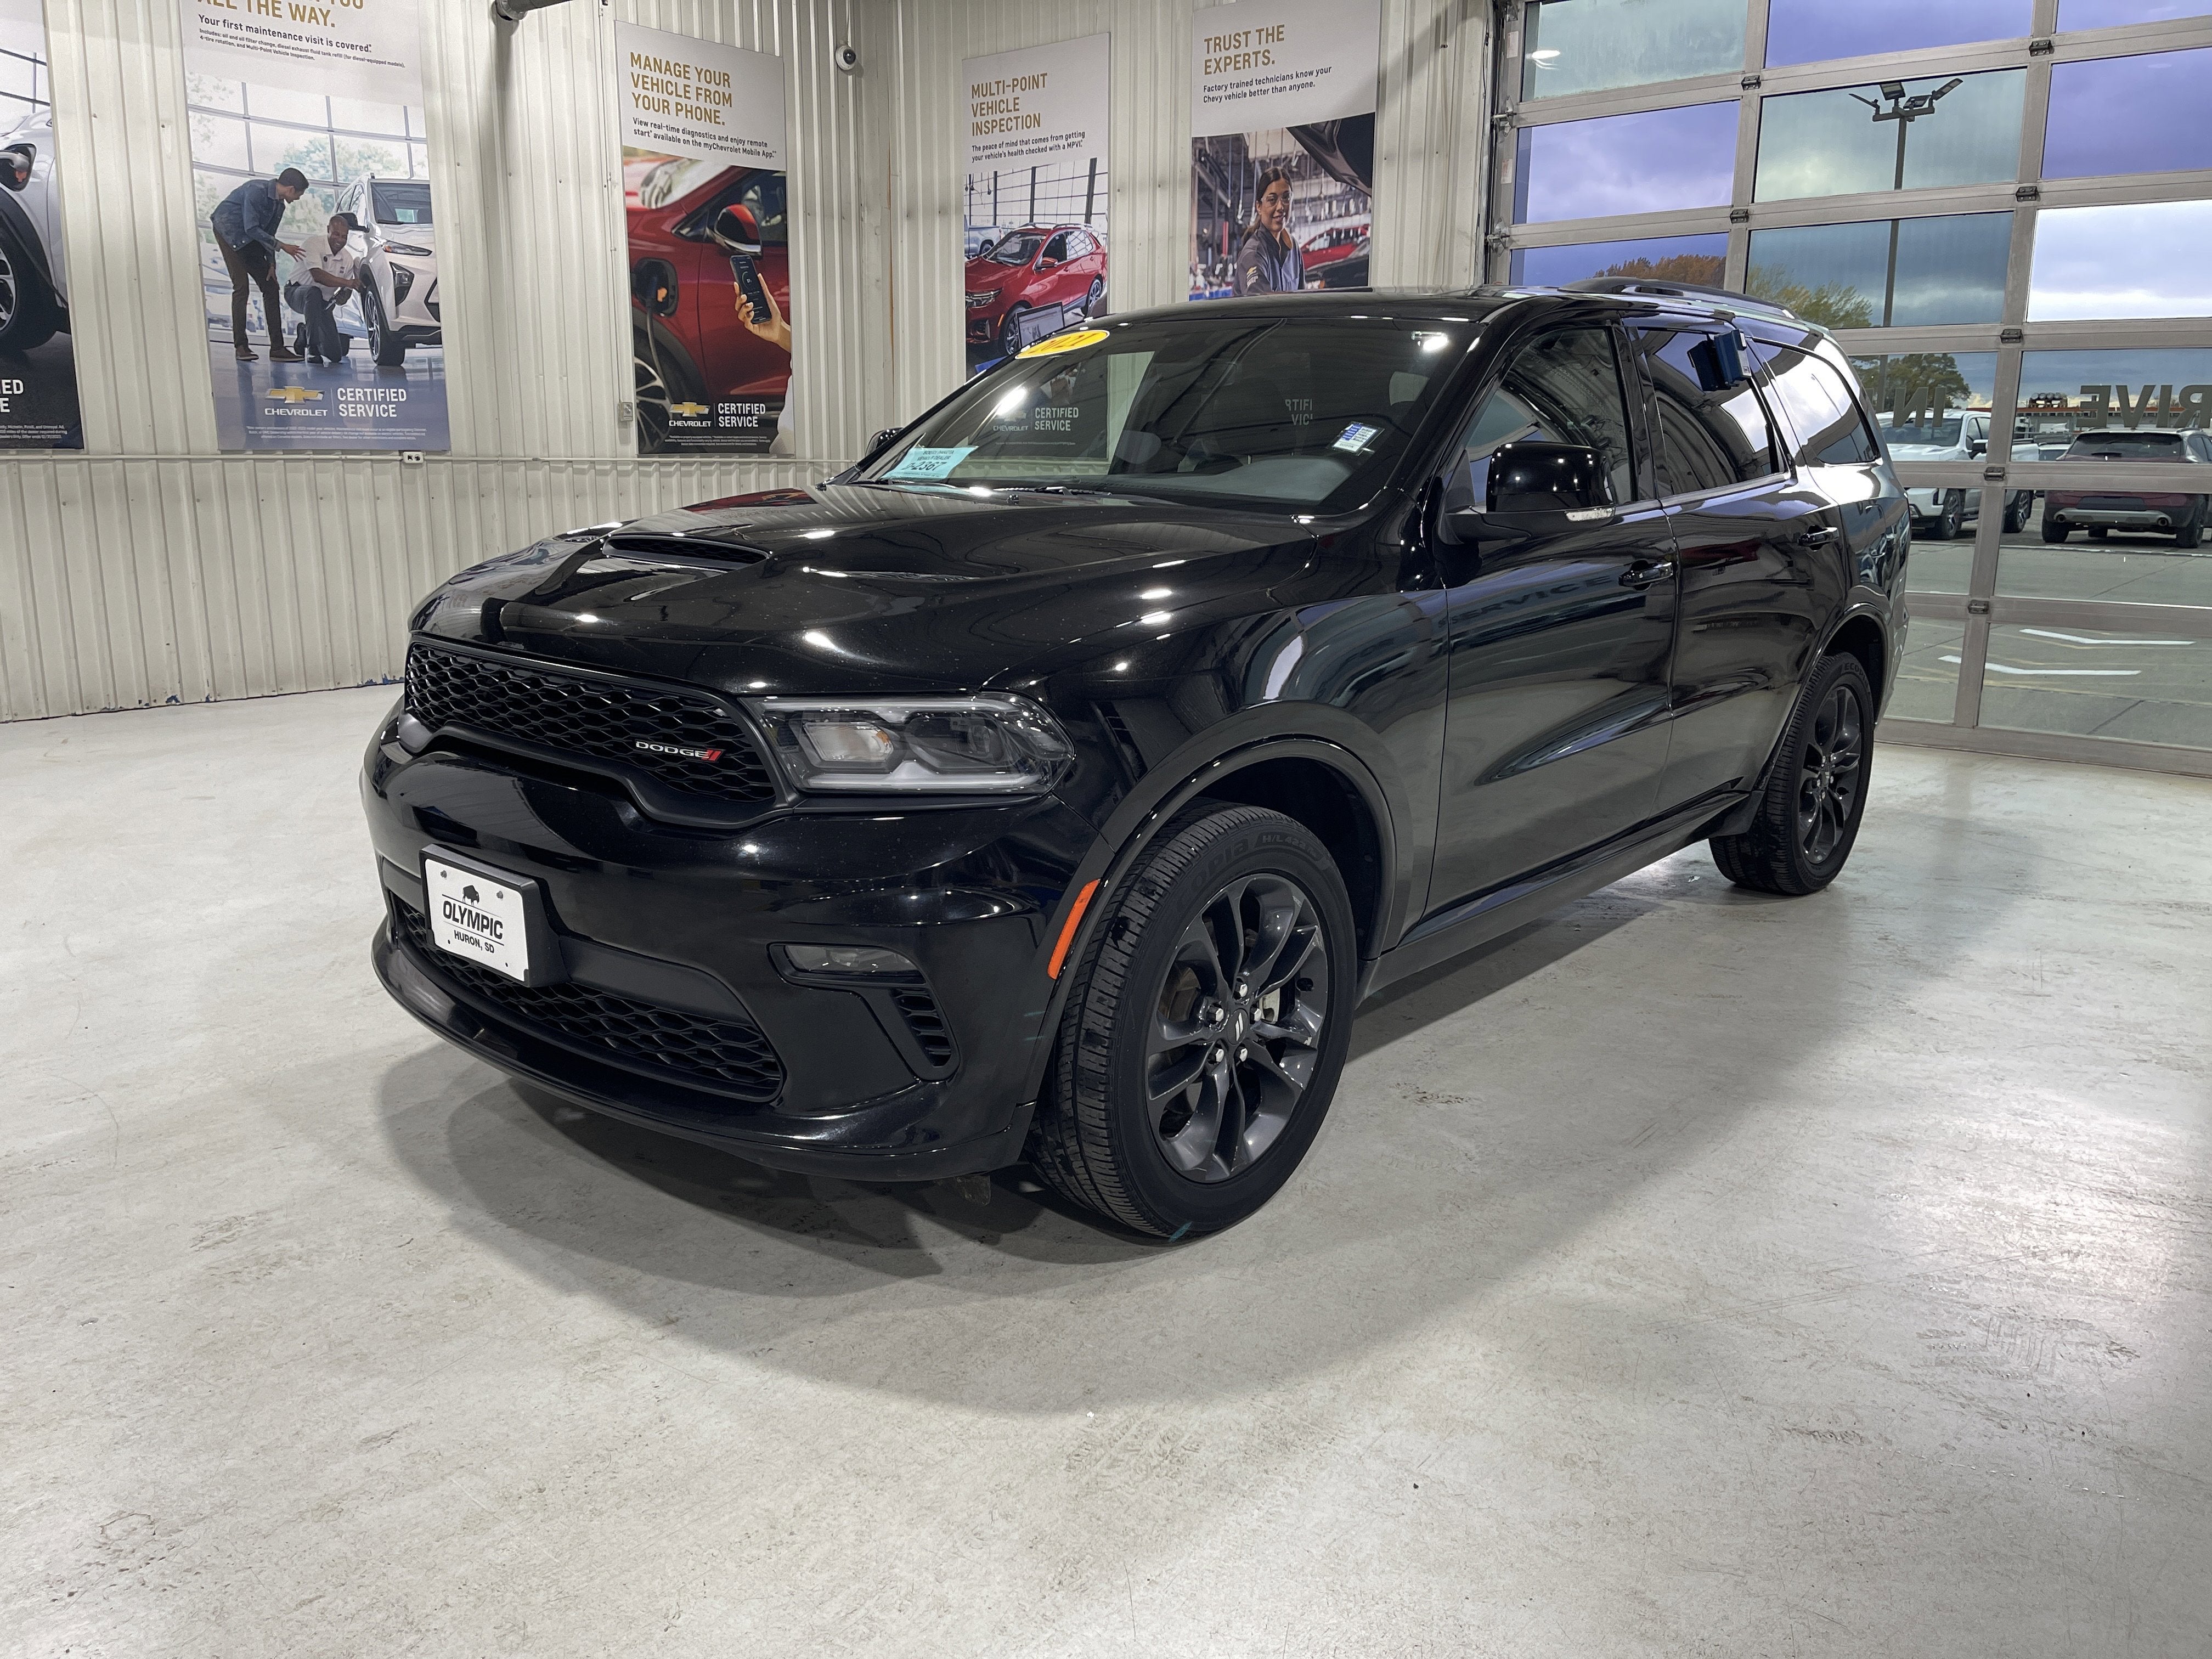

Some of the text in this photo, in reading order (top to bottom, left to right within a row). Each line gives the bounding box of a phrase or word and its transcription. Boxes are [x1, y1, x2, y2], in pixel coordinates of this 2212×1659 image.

[289, 3, 335, 27] WAY.
[199, 14, 220, 26] Your
[223, 19, 243, 31] first
[246, 26, 303, 42] maintenance
[305, 35, 324, 46] visit
[326, 38, 333, 47] is
[1204, 24, 1285, 54] TRUST THE
[630, 52, 731, 88] MANAGE YOUR
[1205, 49, 1276, 75] EXPERTS.
[631, 72, 732, 108] VEHICLE FROM
[972, 73, 1047, 99] MULTI-POINT
[1204, 66, 1332, 93] Factory trained technicians know your
[1204, 81, 1316, 103] Chevy vehicle better than anyone.
[632, 92, 725, 125] YOUR PHONE.
[972, 97, 1020, 117] VEHICLE
[633, 117, 768, 148] View real-time diagnostics and enjoy remote
[972, 112, 1041, 136] INSPECTION
[653, 132, 681, 144] available
[692, 138, 702, 147] the
[703, 142, 741, 154] myChevrolet
[742, 147, 760, 156] Mobile
[972, 155, 983, 163] your
[985, 150, 1006, 160] vehicle's
[1007, 148, 1024, 156] health
[1025, 144, 1047, 155] checked
[1049, 143, 1061, 151] with
[983, 143, 997, 153] peace
[1005, 140, 1018, 148] mind
[1065, 131, 1085, 142] getting
[337, 387, 407, 402] CERTIFIED
[264, 408, 328, 416] CHEVROLET
[338, 404, 397, 417] SERVICE
[718, 403, 766, 415] CERTIFIED
[1035, 407, 1079, 419] CERTIFIED
[719, 416, 758, 427] SERVICE
[1034, 420, 1071, 431] SERVICE
[636, 741, 709, 759] DODGE
[443, 900, 503, 940] OLYMPIC
[454, 930, 495, 953] HURON, SD
